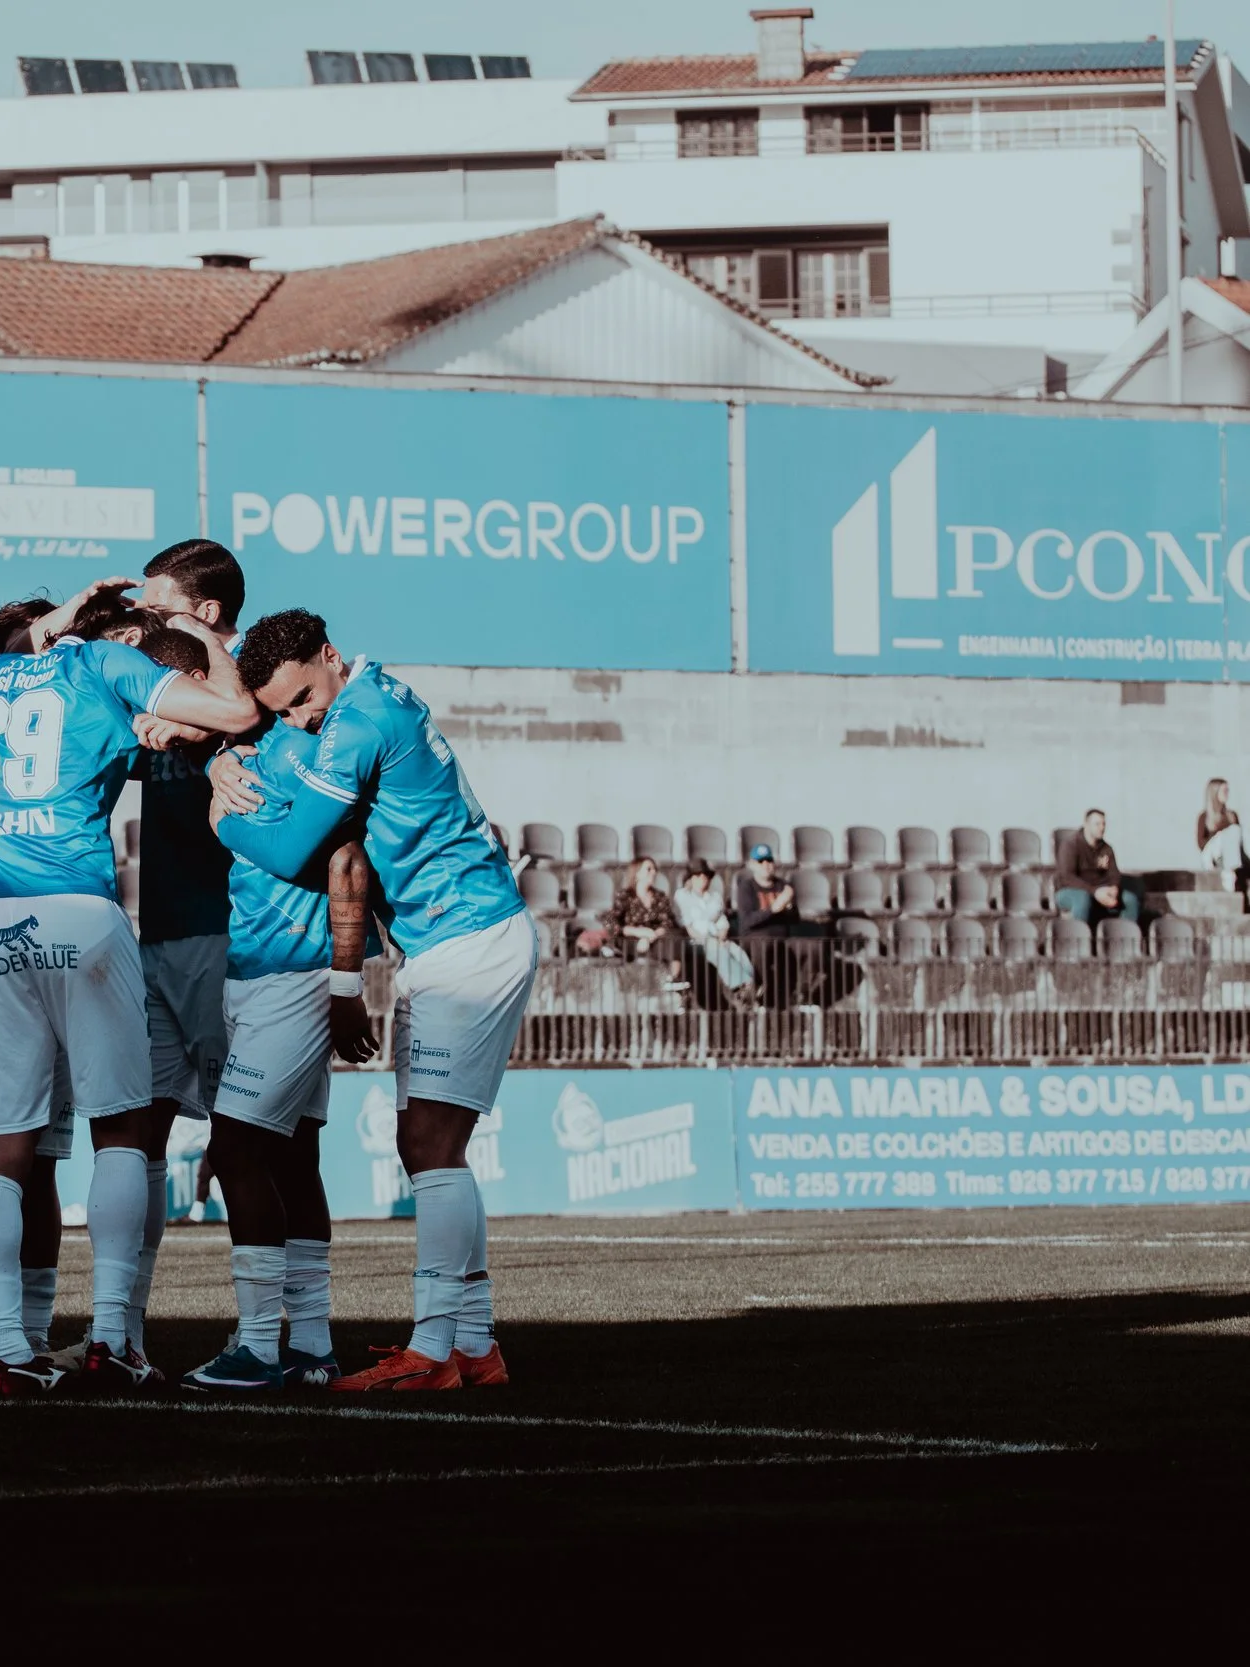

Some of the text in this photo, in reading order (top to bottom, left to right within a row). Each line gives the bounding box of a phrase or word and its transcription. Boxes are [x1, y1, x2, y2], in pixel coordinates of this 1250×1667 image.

[232, 491, 705, 564] POWERGROUP
[958, 634, 1056, 658] ENGENHARIA
[1065, 634, 1167, 663] CONSTRUÇÃO
[32, 949, 79, 970] BLUE
[52, 942, 78, 951] Empire
[420, 1050, 451, 1059] PAREDES
[233, 1066, 266, 1080] PAREDES
[747, 1076, 844, 1118] ANA
[851, 1076, 993, 1118] MARIA
[1000, 1075, 1032, 1117] &
[1038, 1074, 1195, 1124] SOUSA,
[749, 1133, 834, 1160] VENDA
[837, 1132, 871, 1159] DE
[874, 1126, 1005, 1159] COLCHÕES
[1008, 1132, 1024, 1157] E
[1027, 1130, 1131, 1157] ARTIGOS
[1134, 1130, 1167, 1156] DE
[567, 1128, 697, 1202] NACIONAL
[751, 1172, 791, 1198] Tel:
[795, 1172, 840, 1197] 255
[844, 1171, 888, 1196] 777
[1055, 1168, 1099, 1194] 377
[1102, 1167, 1145, 1193] 715
